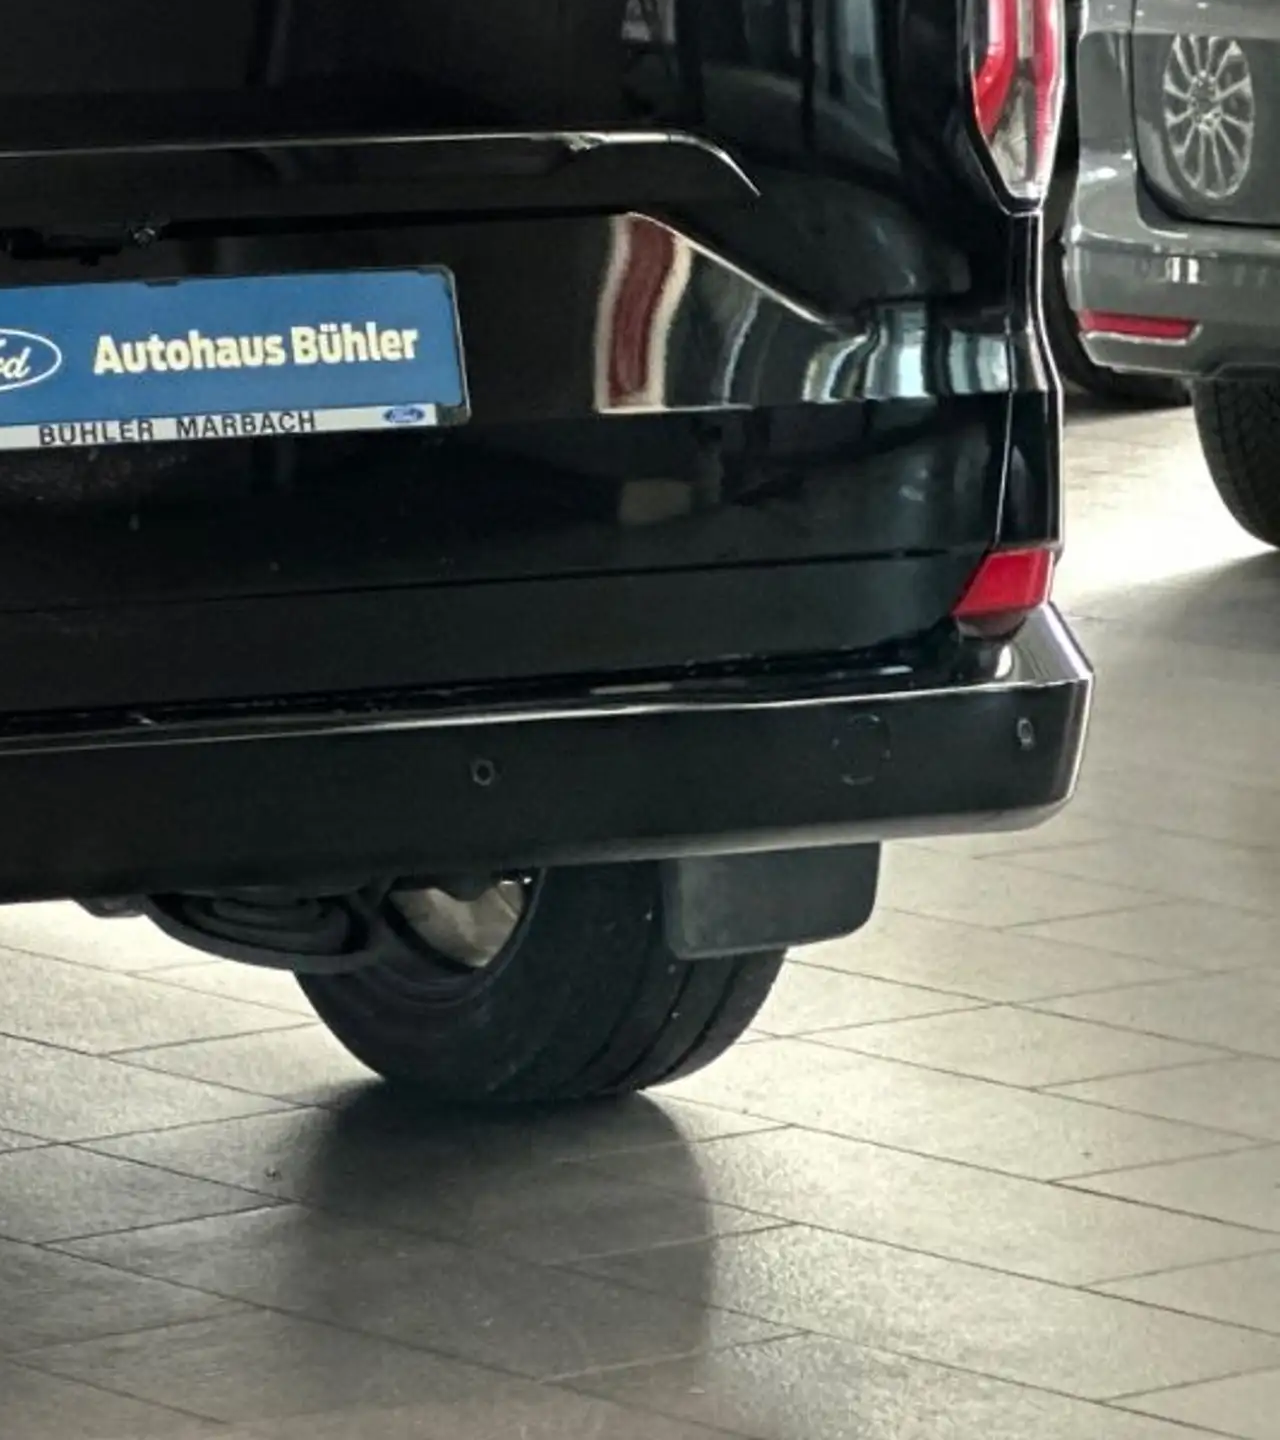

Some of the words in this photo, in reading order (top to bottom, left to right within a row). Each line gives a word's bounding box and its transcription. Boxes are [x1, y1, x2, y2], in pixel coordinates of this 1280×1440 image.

[93, 329, 287, 376] Autohaus
[291, 319, 420, 366] Bühler
[177, 410, 317, 440] MARBACH
